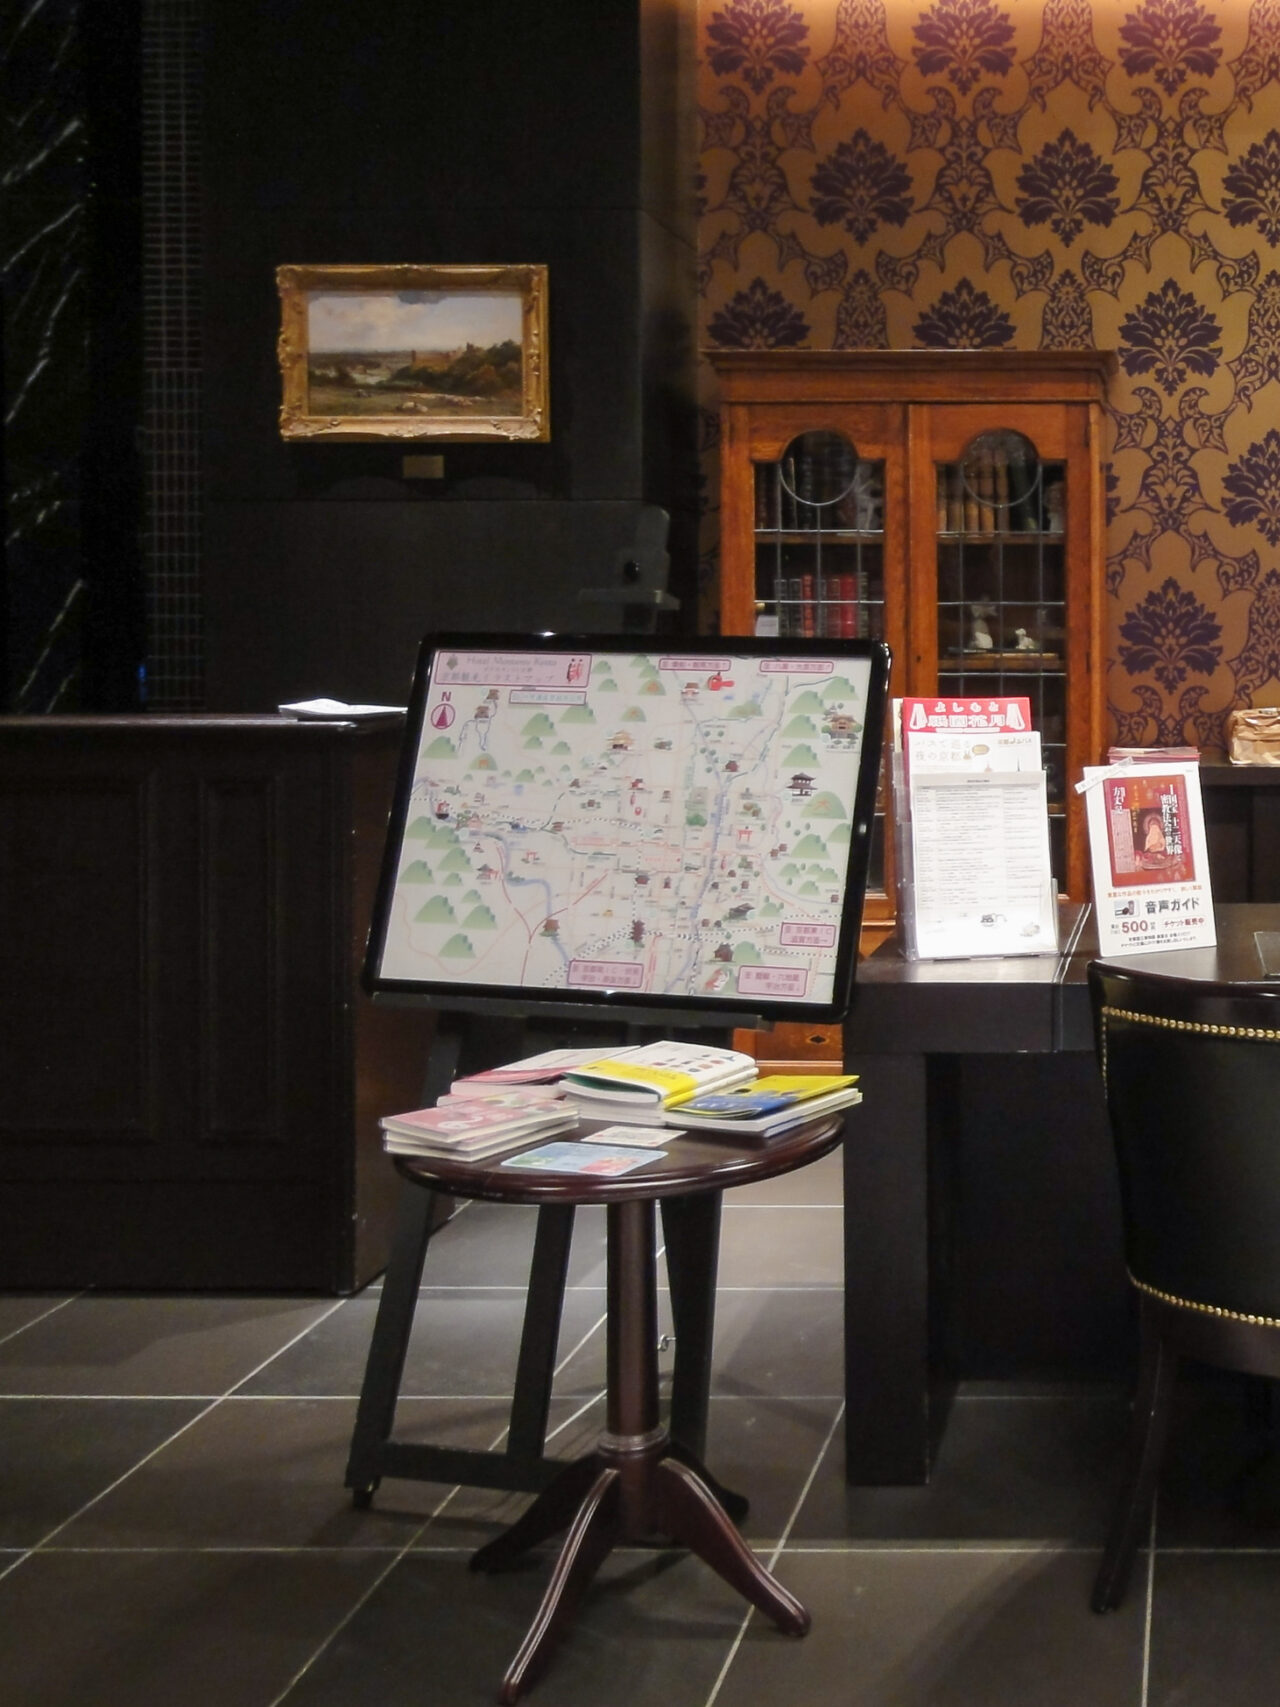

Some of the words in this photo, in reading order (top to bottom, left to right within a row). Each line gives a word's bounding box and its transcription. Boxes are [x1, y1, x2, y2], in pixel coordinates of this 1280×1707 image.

[441, 691, 452, 701] N
[935, 701, 999, 712] よしもと
[1145, 897, 1200, 914] 音声ガイド
[1122, 920, 1149, 933] 500
[1164, 918, 1204, 928] チケット販売中
